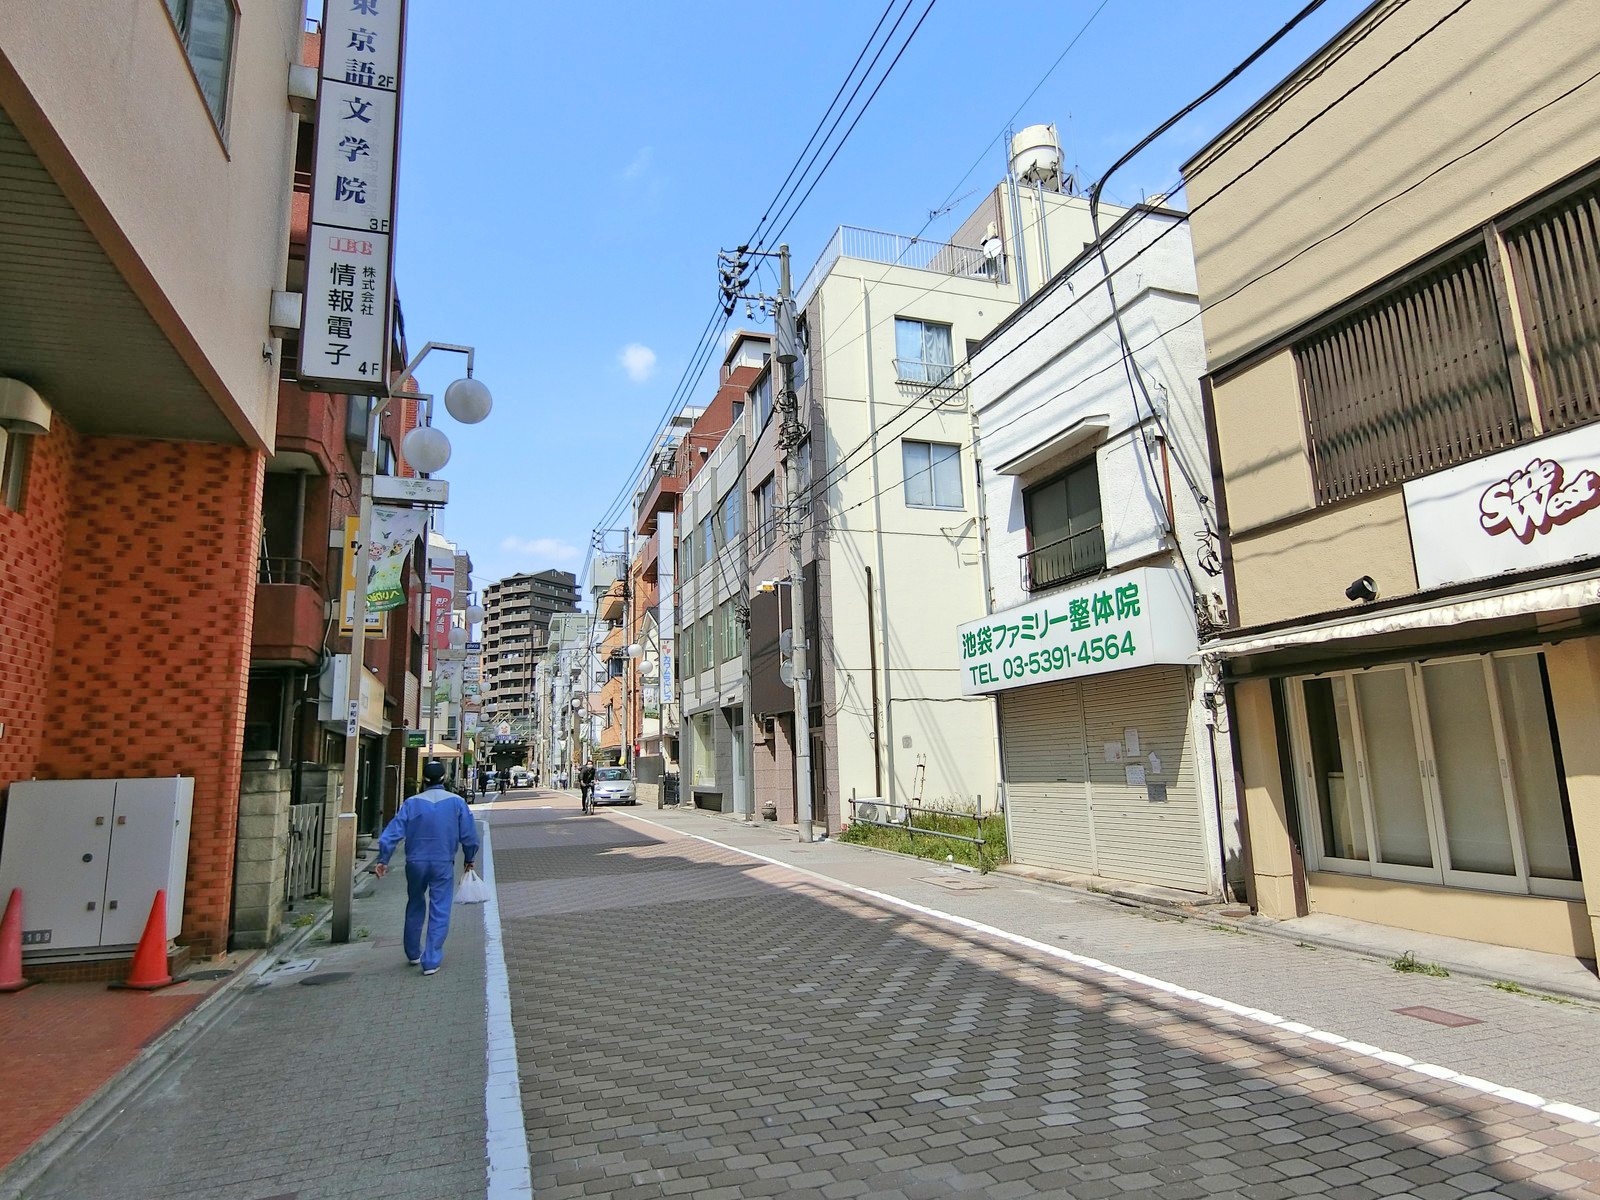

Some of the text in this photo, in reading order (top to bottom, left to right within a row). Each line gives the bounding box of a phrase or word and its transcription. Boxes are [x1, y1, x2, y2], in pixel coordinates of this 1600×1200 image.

[377, 74, 395, 88] 2F
[369, 218, 389, 232] 3F
[360, 265, 377, 316] 株式会社
[324, 262, 357, 366] 情報電子
[358, 361, 380, 376] 4F
[962, 582, 1141, 660] 池袋ファミリー整体院
[969, 630, 1137, 686] TEL 03-5391-4564
[348, 702, 358, 734] 平和通り
